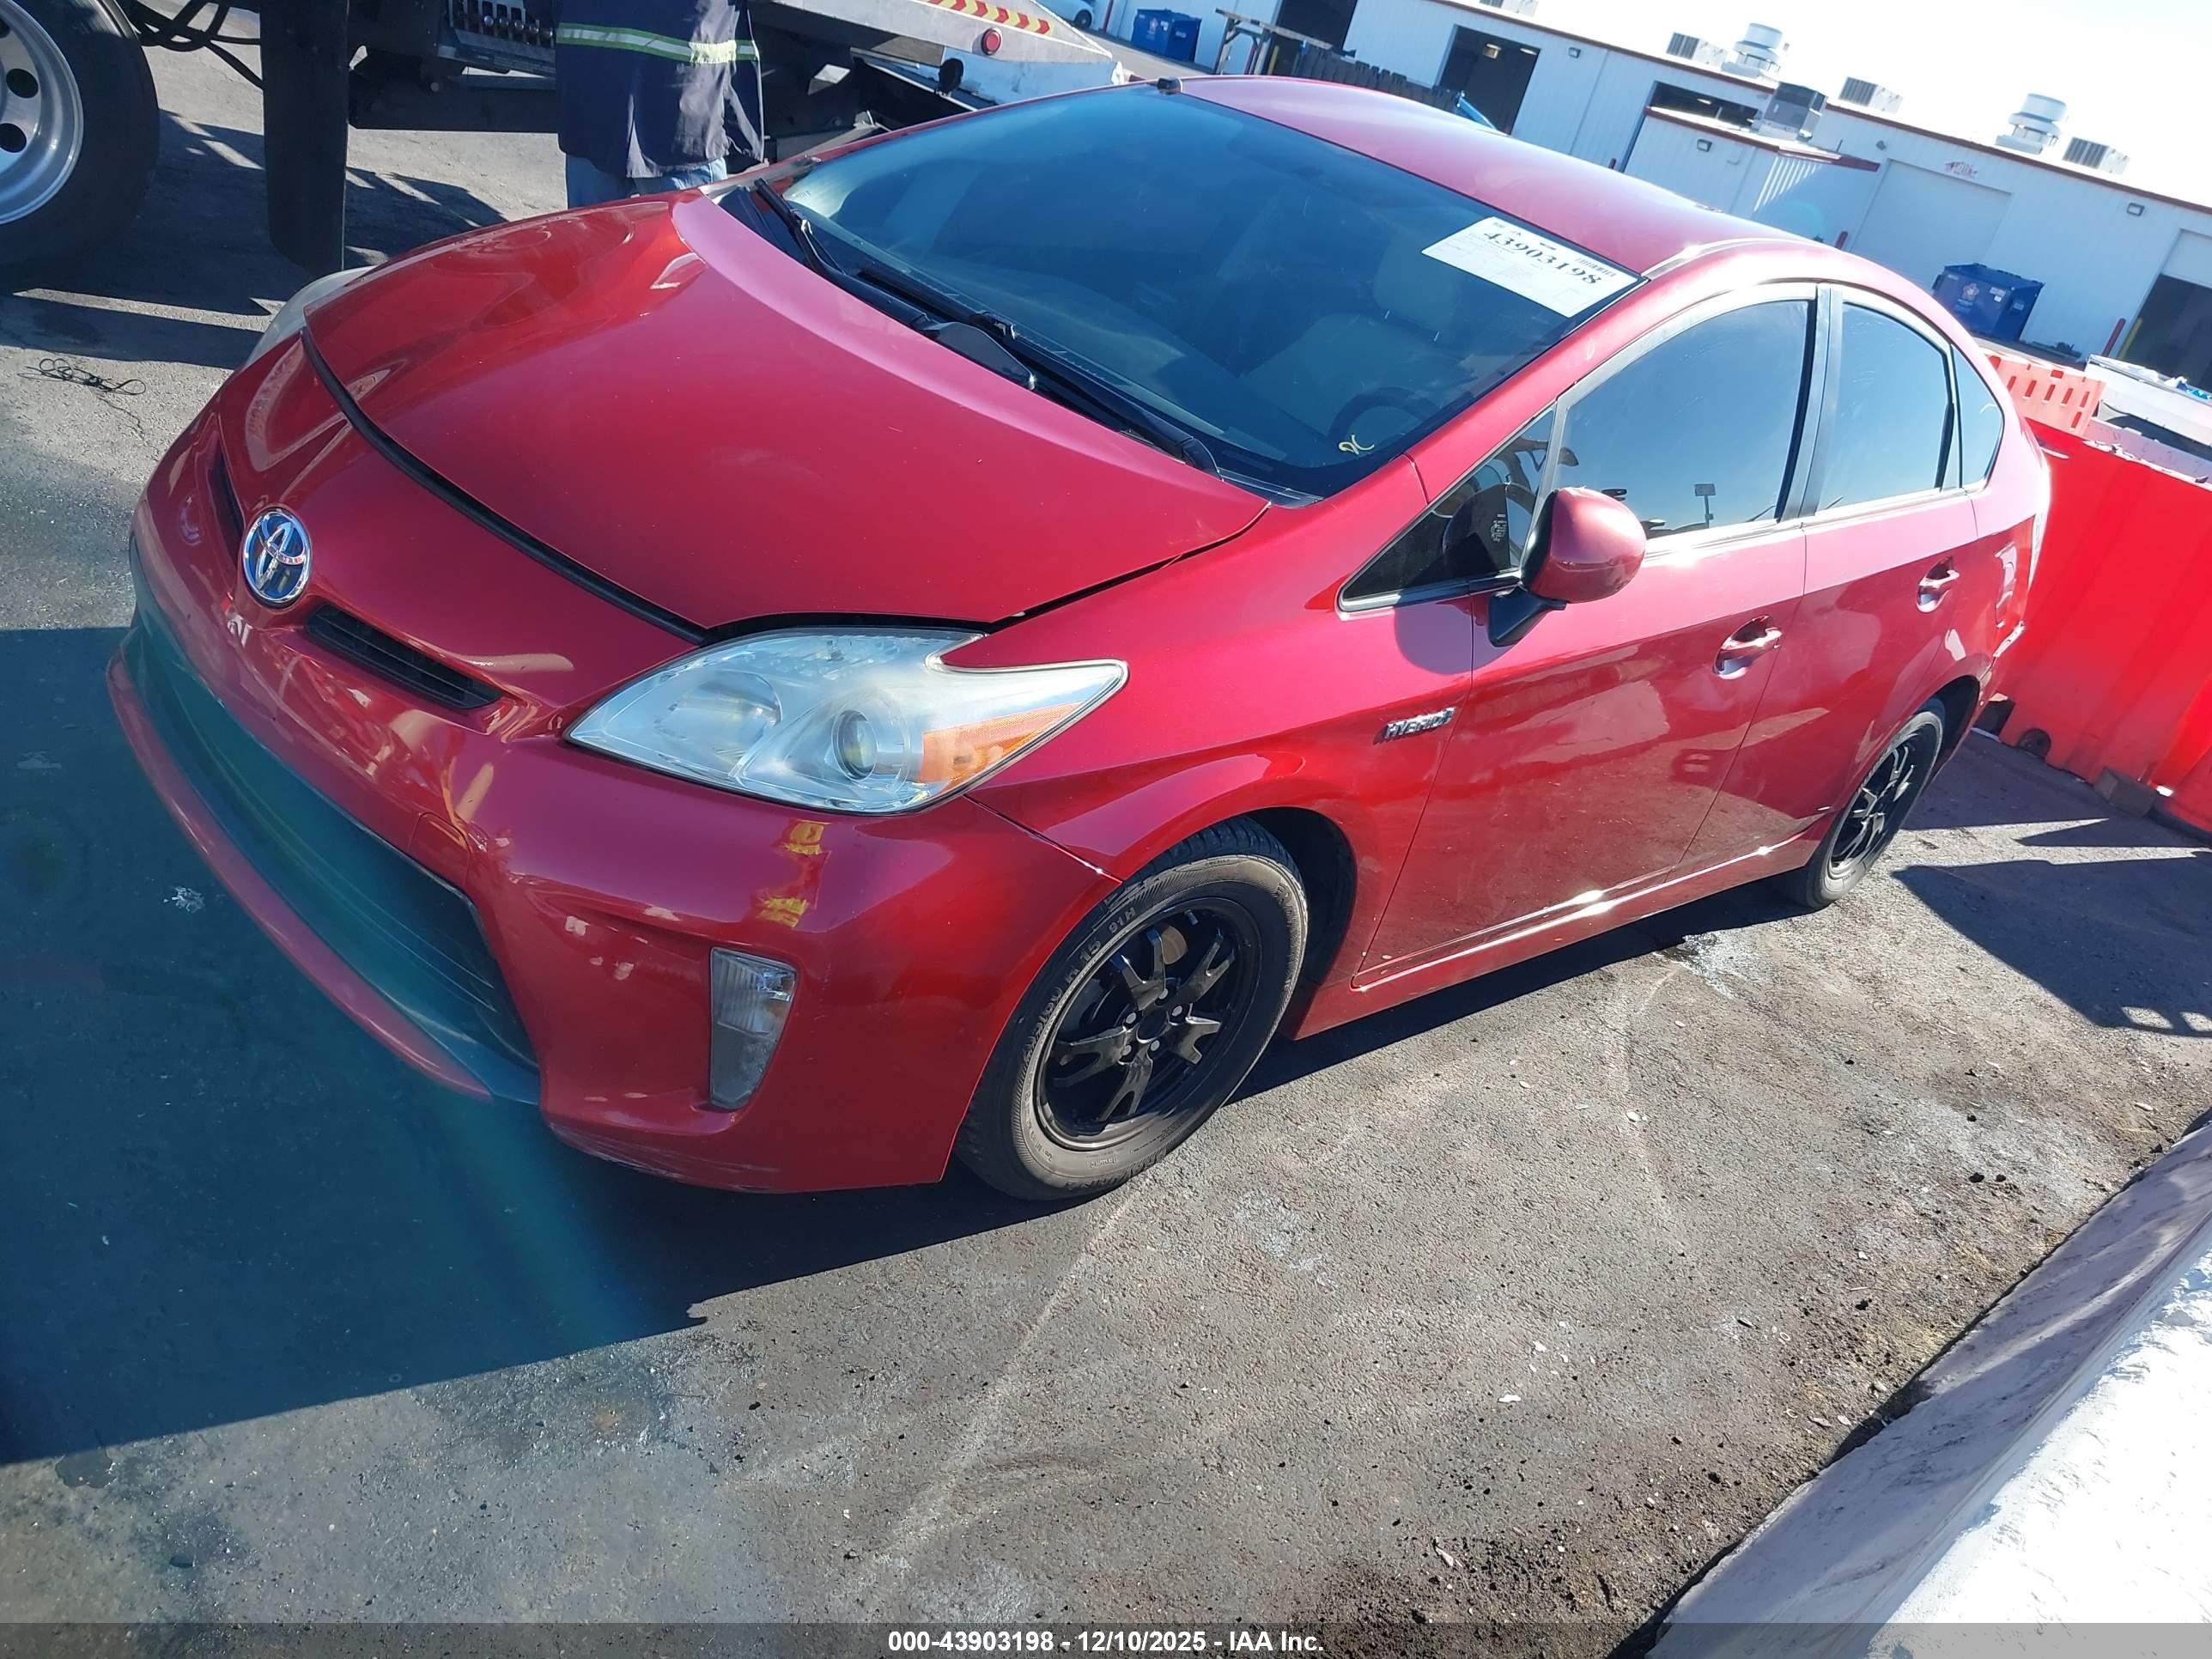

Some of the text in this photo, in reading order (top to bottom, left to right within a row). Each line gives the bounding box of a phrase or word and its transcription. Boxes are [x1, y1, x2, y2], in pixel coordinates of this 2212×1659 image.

[1485, 232, 1602, 284] 43903198
[1384, 707, 1456, 739] HYBRID
[1079, 938, 1102, 961] 15
[1109, 907, 1135, 934] 91H
